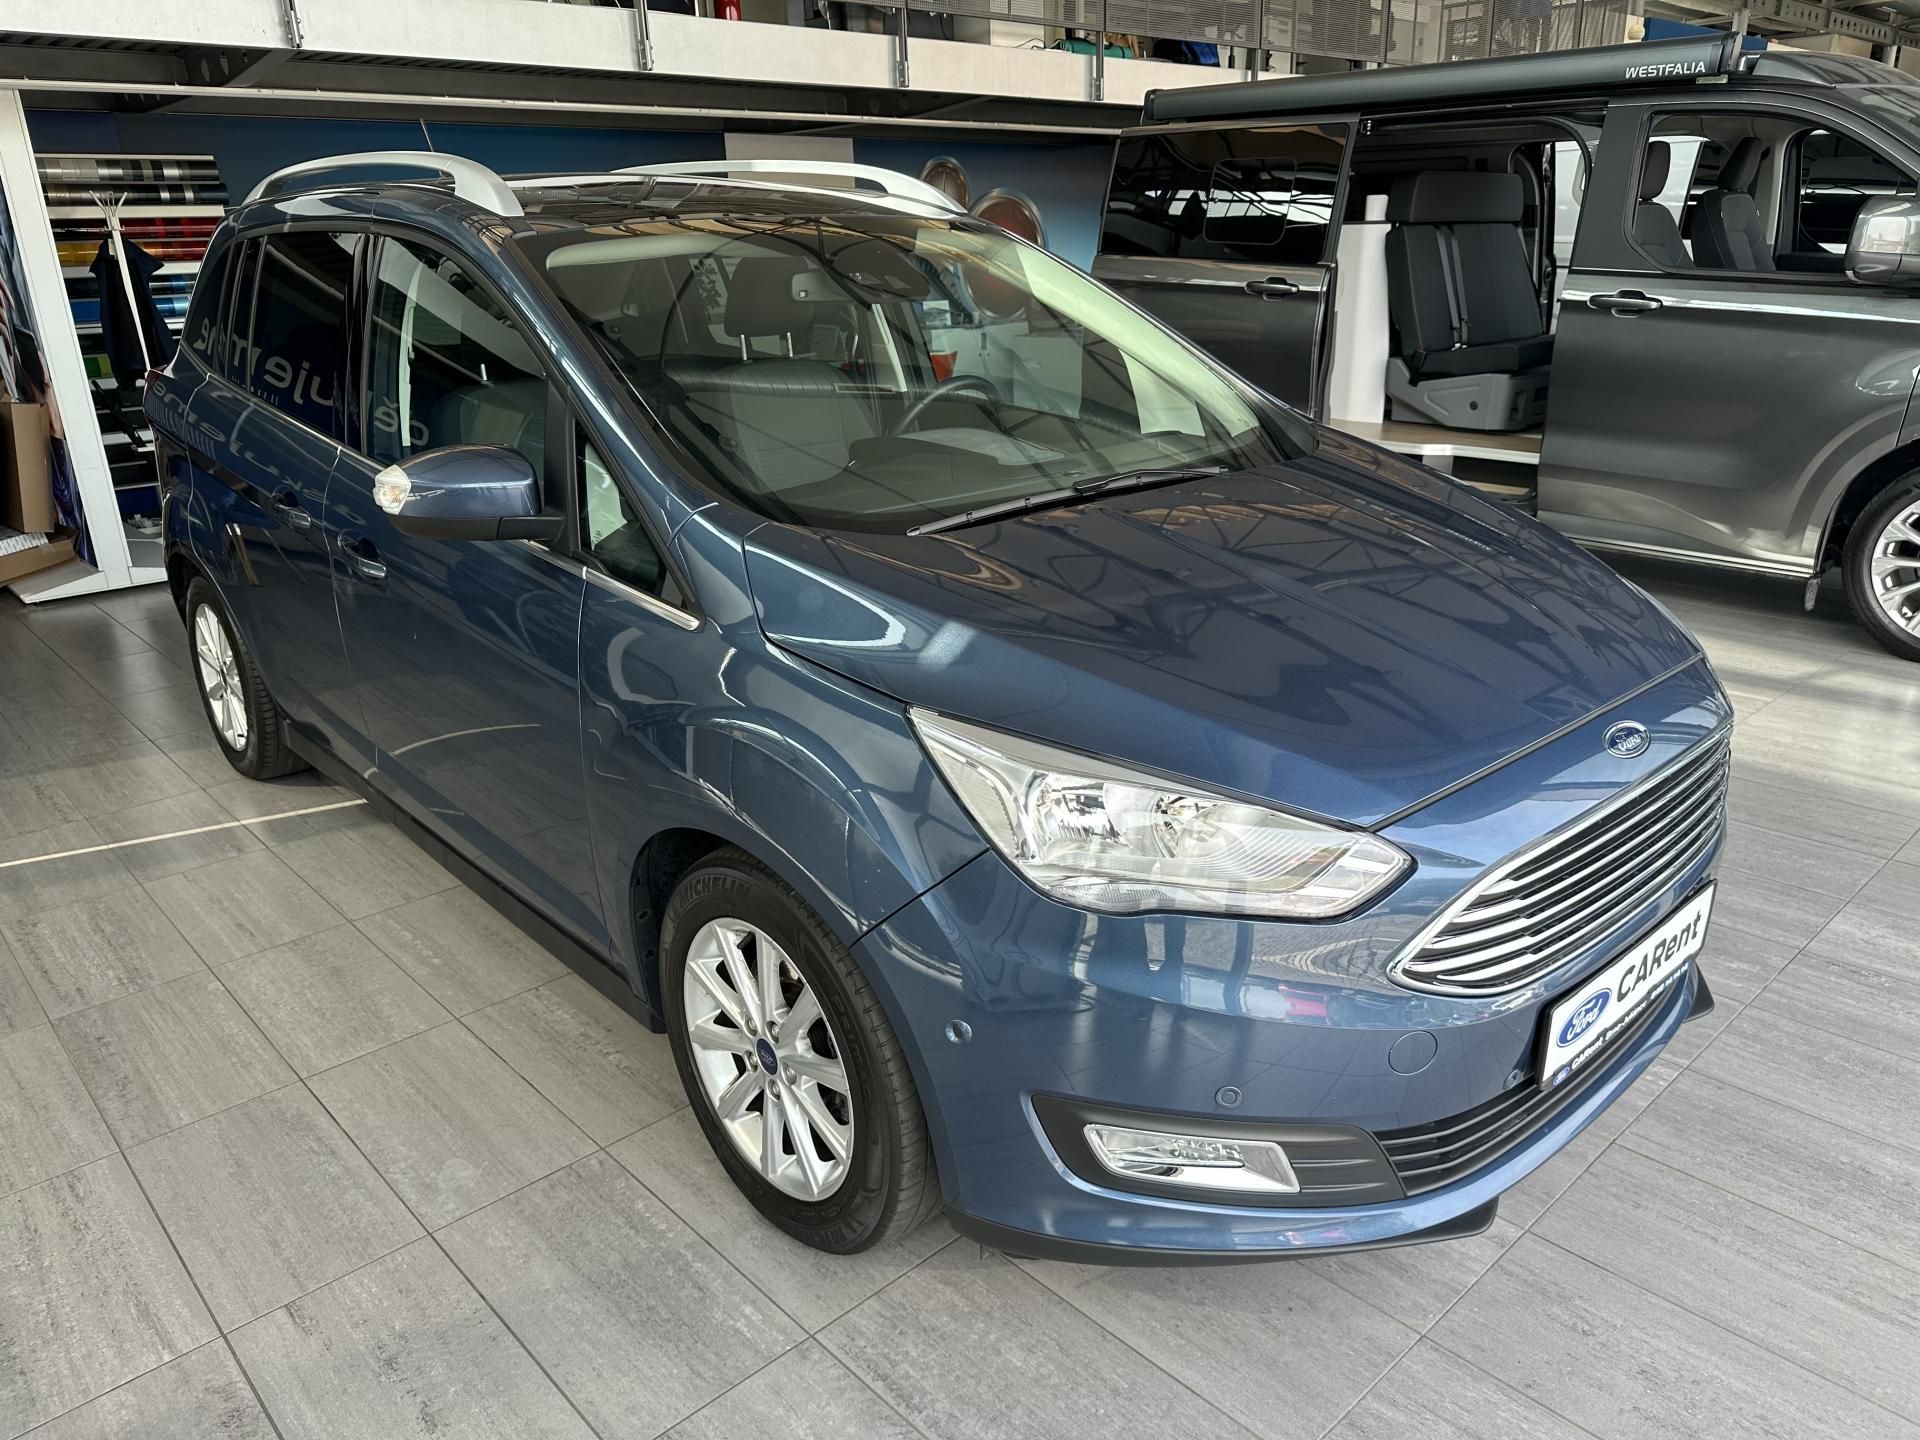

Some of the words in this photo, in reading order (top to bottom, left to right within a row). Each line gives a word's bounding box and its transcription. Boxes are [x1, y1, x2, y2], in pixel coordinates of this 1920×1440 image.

[1625, 61, 1706, 79] WESTFALIA
[1617, 910, 1702, 1003] CARent
[1566, 998, 1603, 1041] Ford
